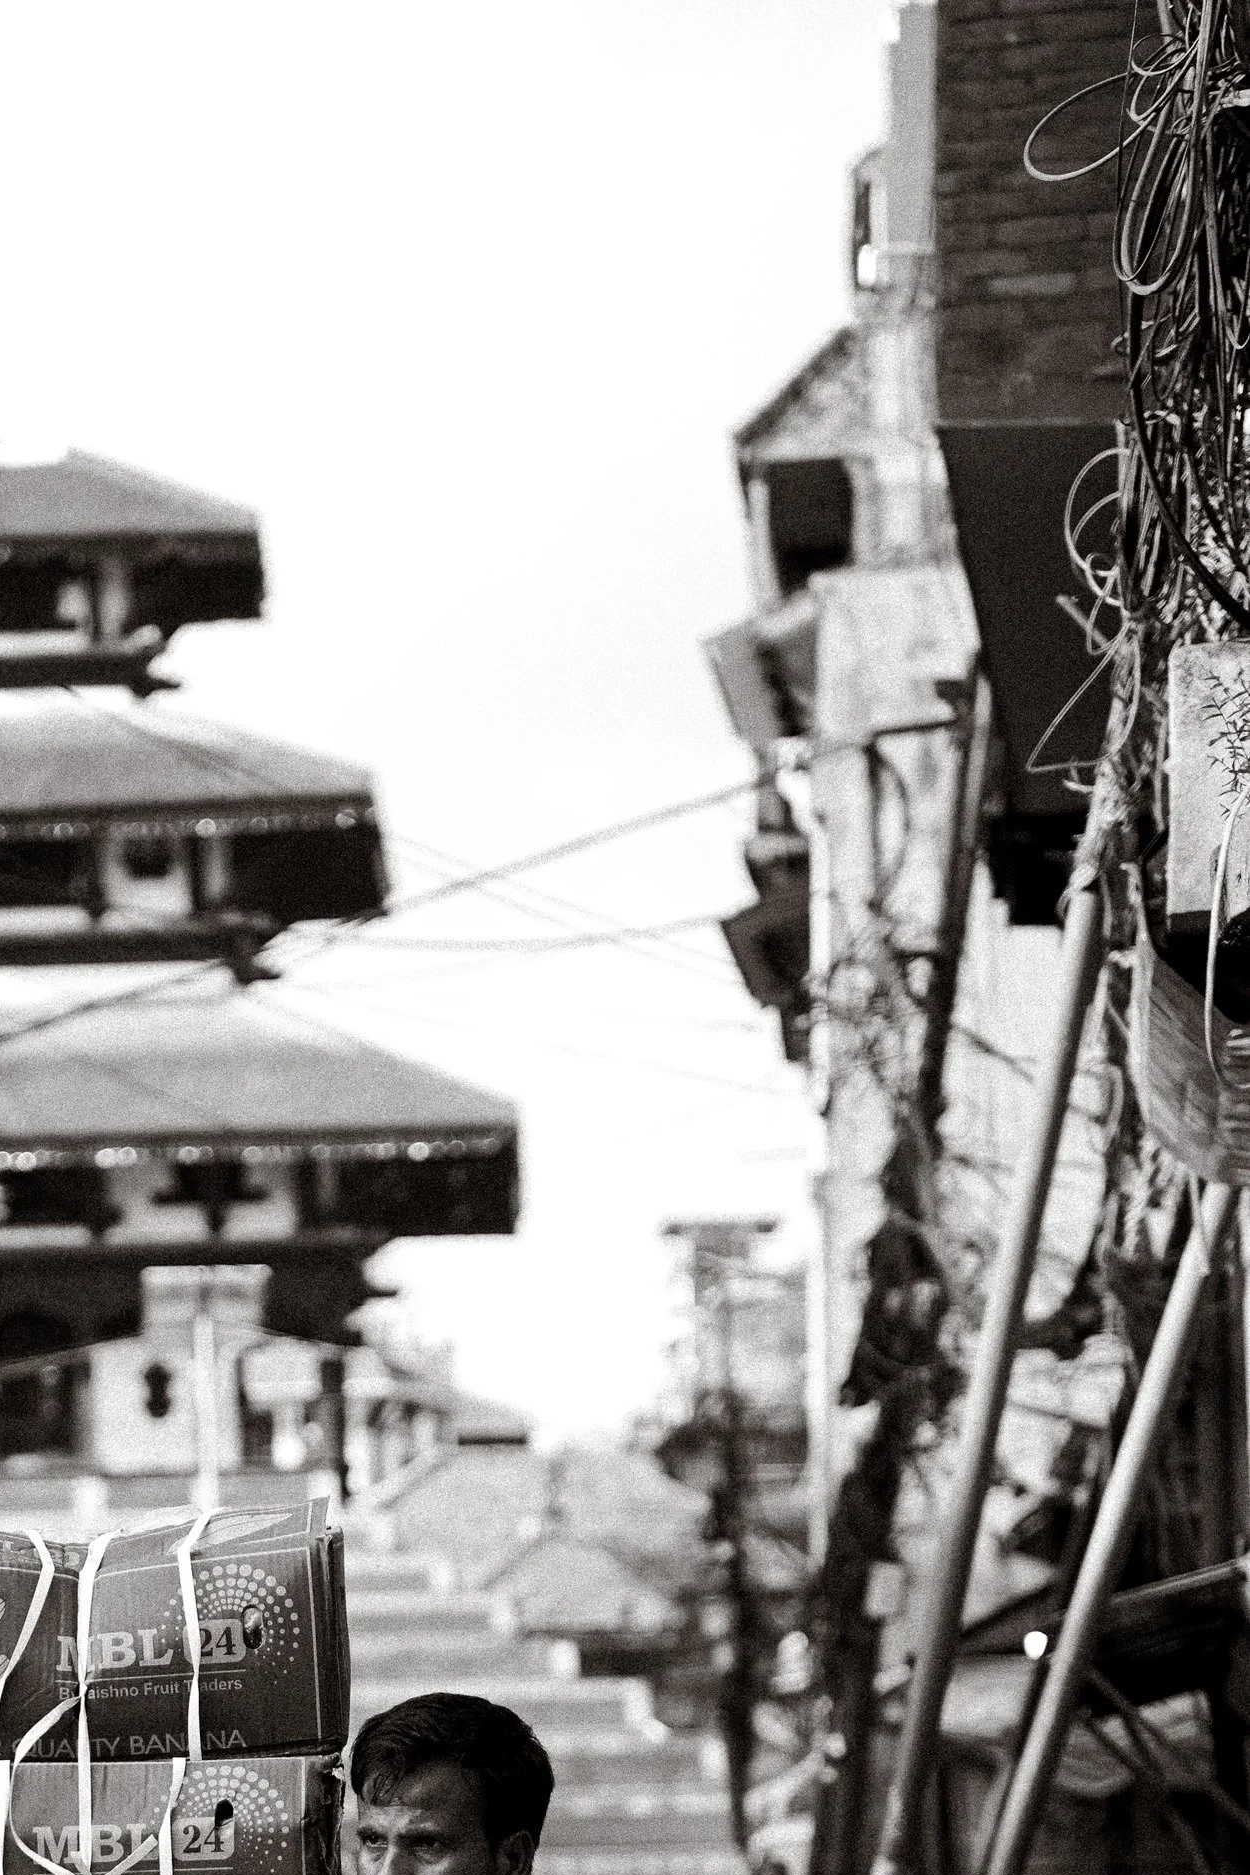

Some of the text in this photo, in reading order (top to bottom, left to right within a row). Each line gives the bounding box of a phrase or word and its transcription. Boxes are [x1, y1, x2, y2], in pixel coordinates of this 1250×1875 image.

[56, 1627, 237, 1673] MBL 24
[83, 1683, 139, 1700] aishno
[144, 1681, 180, 1696] Fruit
[183, 1678, 243, 1693] Taders
[32, 1822, 225, 1865] MBL 24
